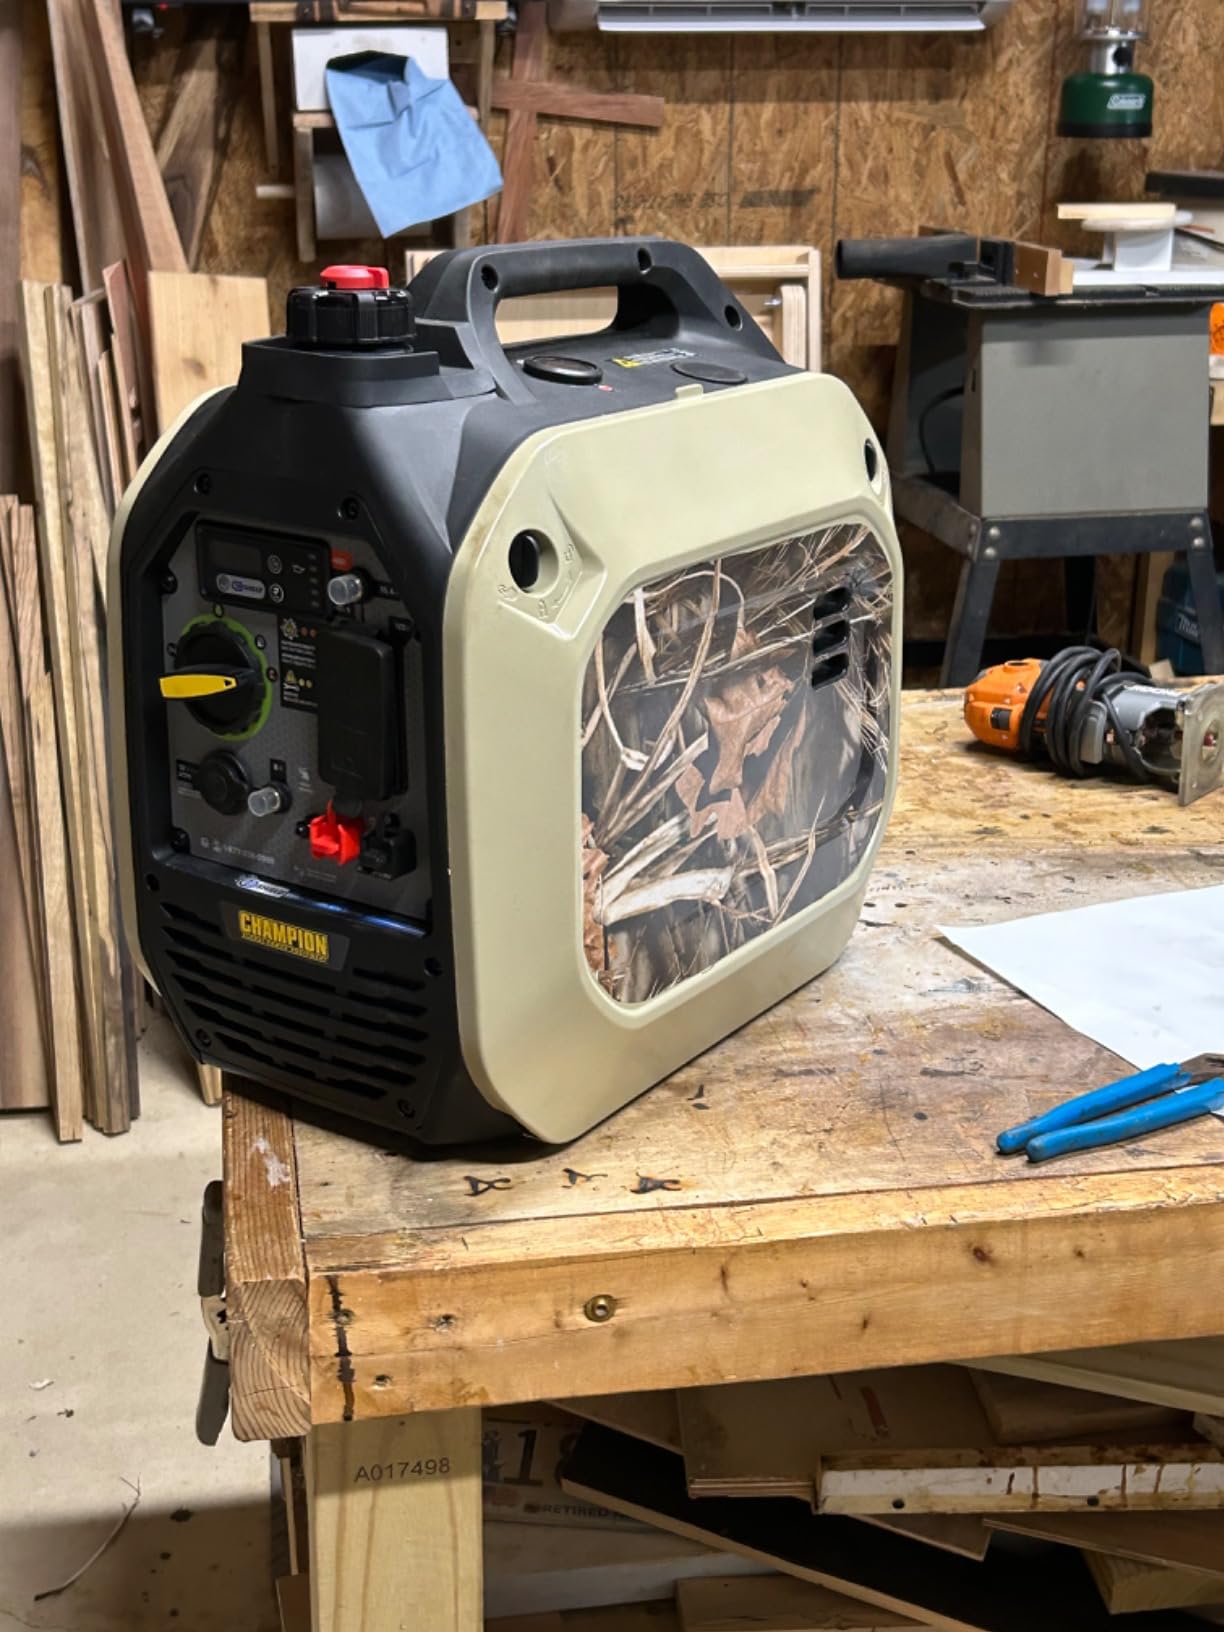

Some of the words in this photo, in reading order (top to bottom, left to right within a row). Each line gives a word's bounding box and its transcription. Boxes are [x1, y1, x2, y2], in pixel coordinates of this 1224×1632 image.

[238, 910, 329, 955] CHAMPION
[353, 1457, 450, 1483] A017498
[542, 1503, 609, 1517] RETIRED
